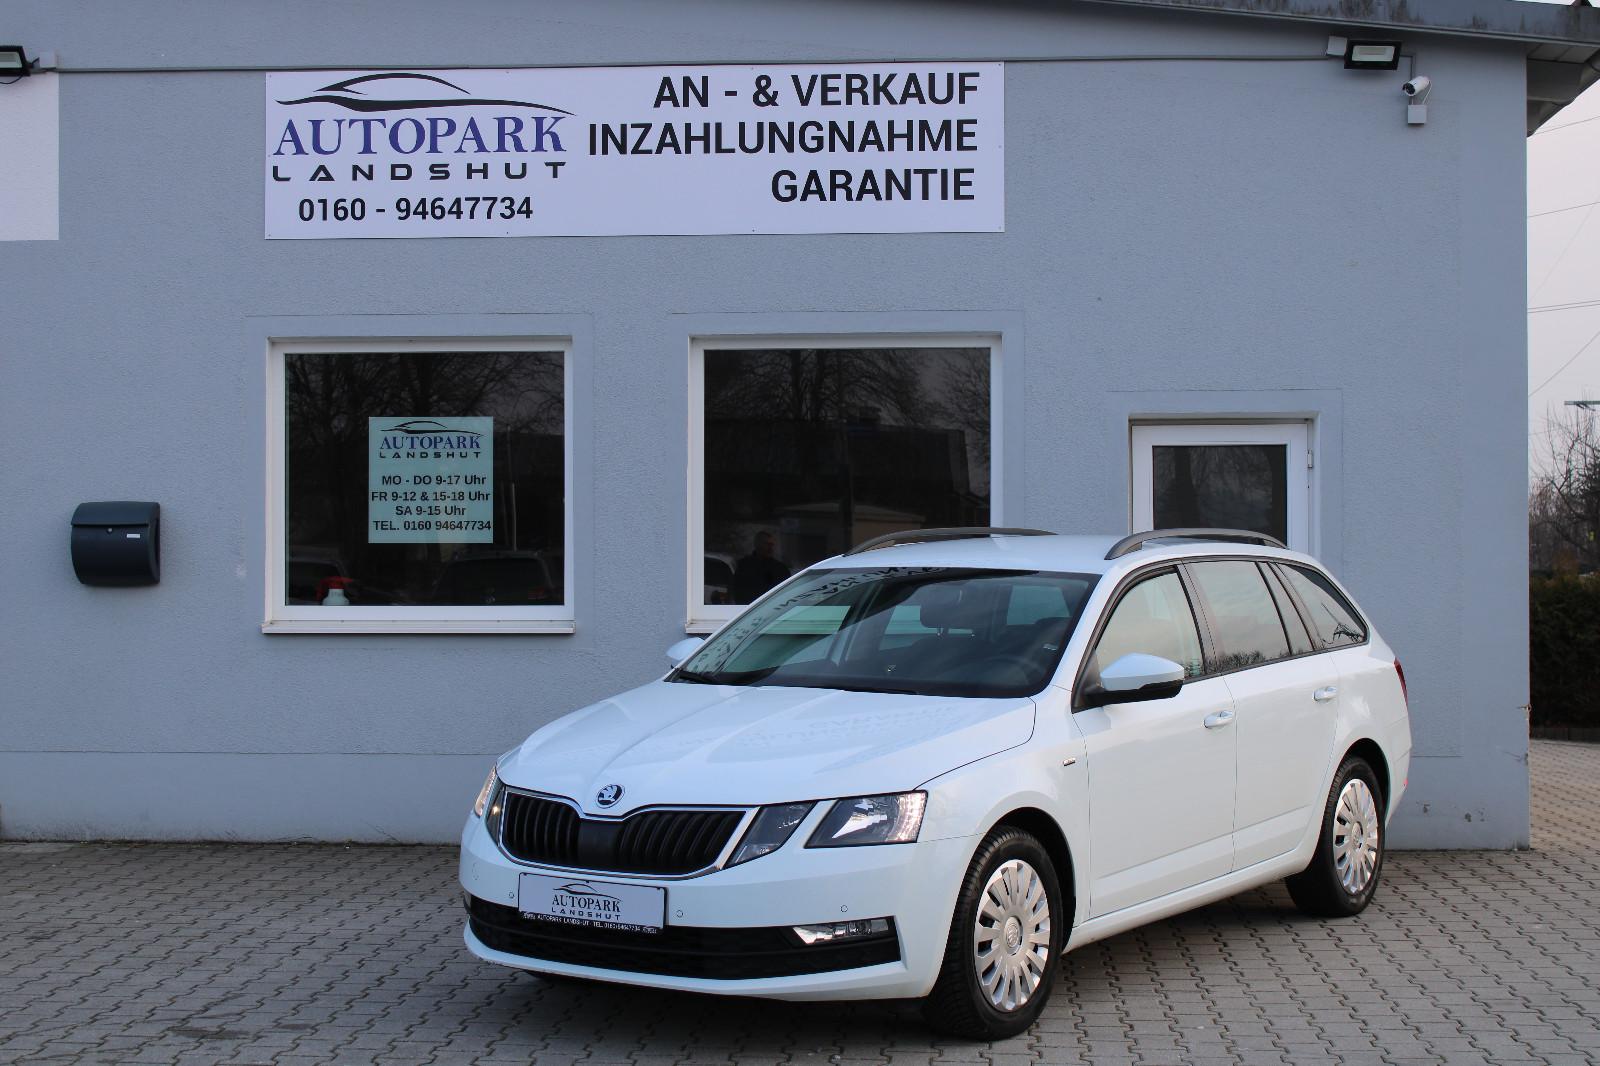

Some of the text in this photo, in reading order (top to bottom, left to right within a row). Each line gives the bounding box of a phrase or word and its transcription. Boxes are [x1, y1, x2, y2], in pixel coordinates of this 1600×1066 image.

[654, 75, 709, 109] AN
[752, 74, 781, 108] &
[790, 72, 980, 107] VERKAUF
[272, 117, 567, 156] AUTOPARK
[589, 119, 978, 156] INZAHLUNGNAHME
[272, 161, 567, 182] LANDSHUT
[771, 168, 975, 203] GARANTIE
[298, 198, 366, 222] 0160
[395, 197, 534, 221] 94647734
[380, 435, 481, 450] AUTOPARK
[379, 451, 481, 459] LANDSHUT
[382, 475, 402, 486] MO
[413, 475, 432, 485] DO
[435, 475, 461, 485] 9-17
[464, 474, 487, 485] Uhr
[371, 491, 491, 501] FR 9-12 & 15-18 Uhr
[395, 505, 467, 516] SA 9-15 Uhr
[373, 520, 492, 531] TEL. 0160 94647734
[552, 894, 621, 912] AUTOPARK
[551, 908, 621, 920] LANDSHUT
